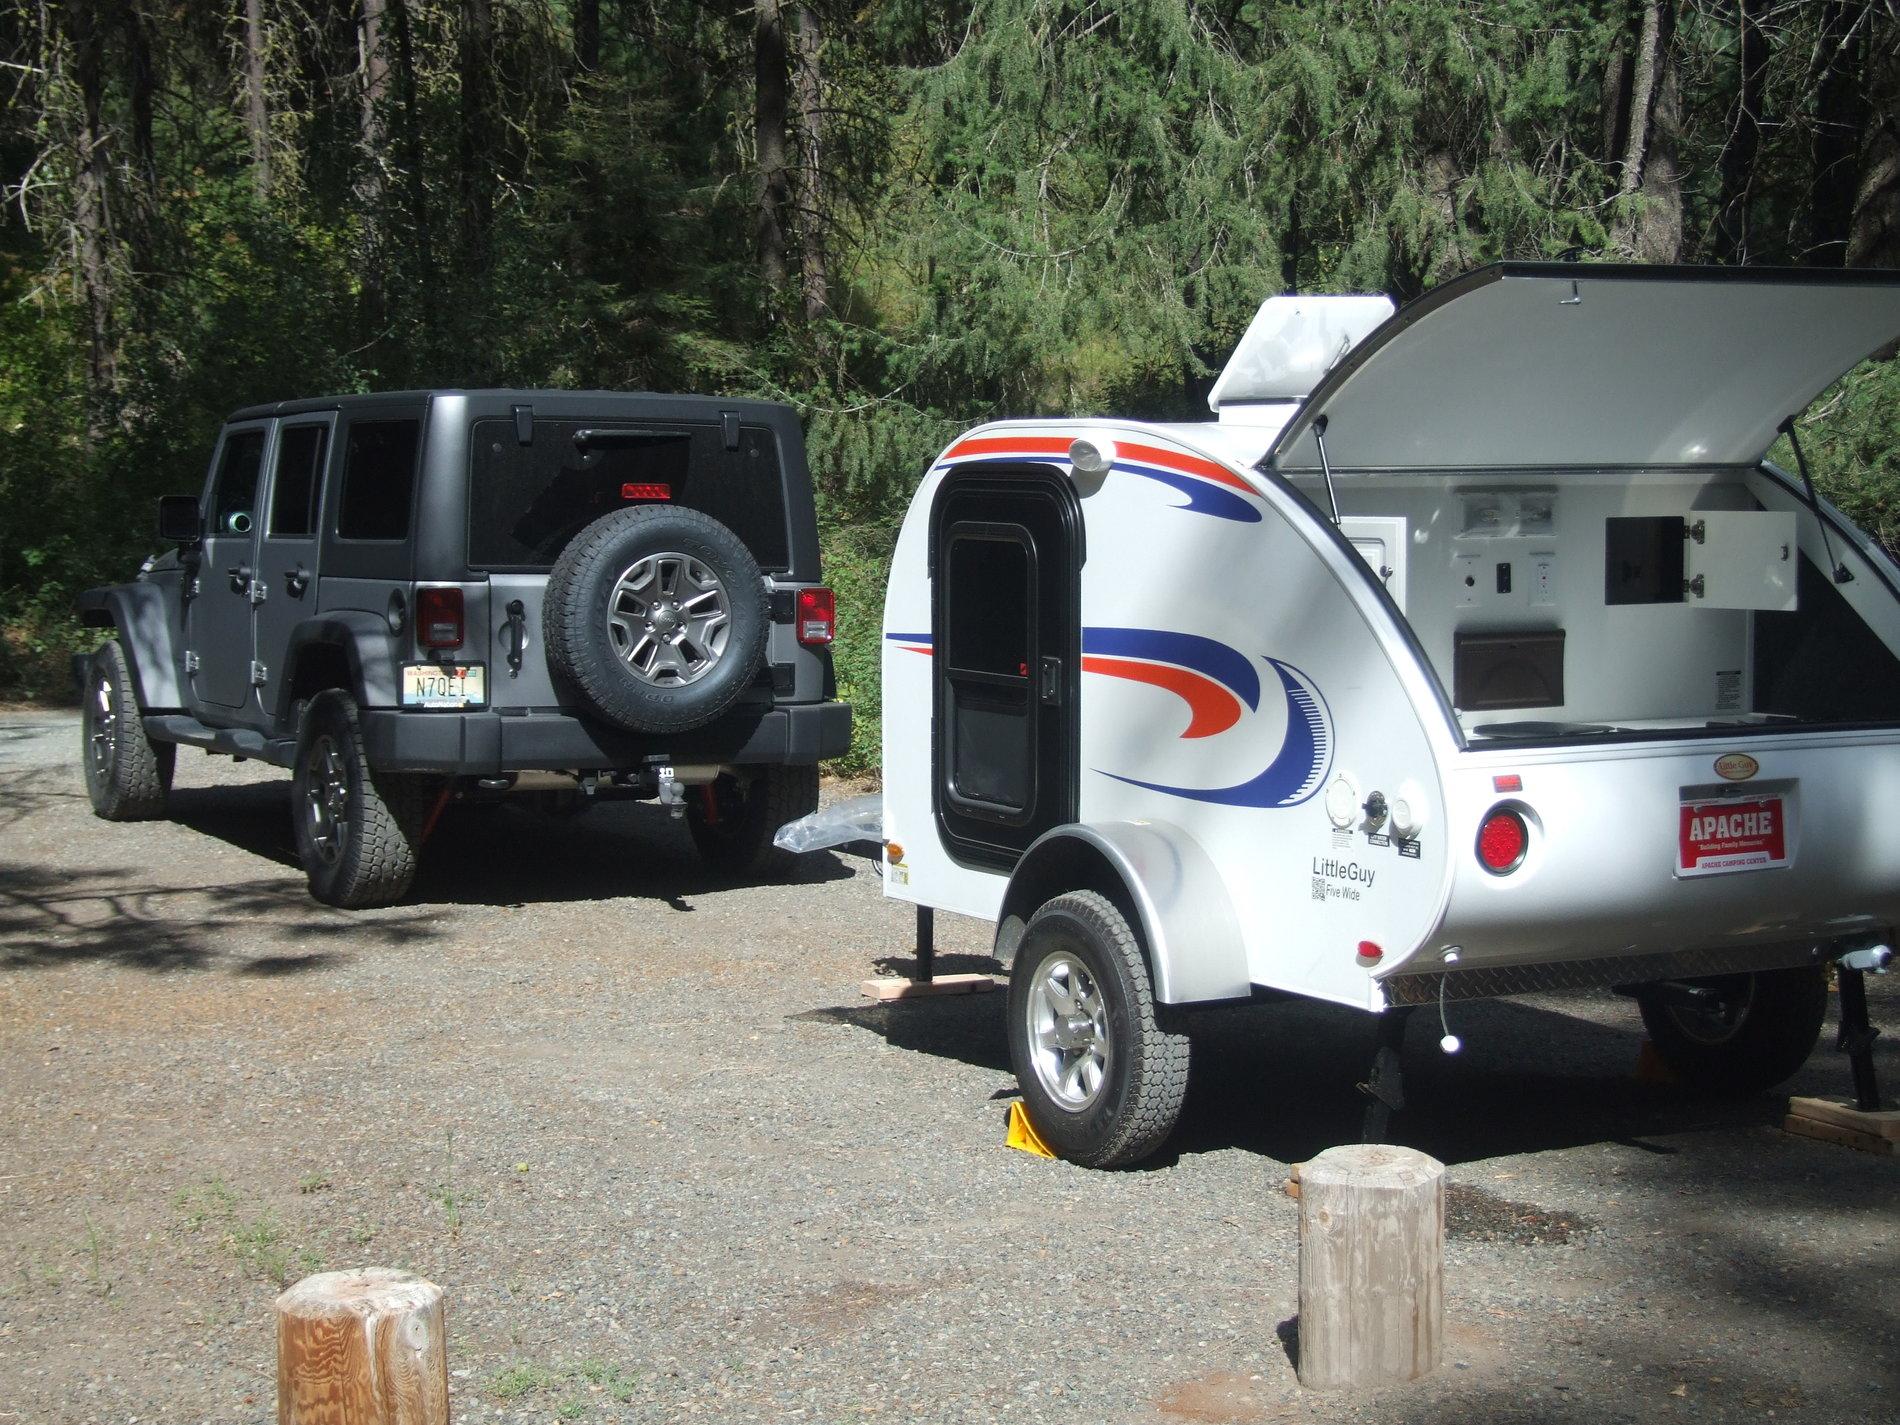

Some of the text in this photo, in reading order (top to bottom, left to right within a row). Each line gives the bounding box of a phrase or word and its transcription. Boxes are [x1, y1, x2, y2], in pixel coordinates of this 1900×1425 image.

[1689, 811, 1772, 842] APACHE
[1325, 883, 1361, 901] Five Wide
